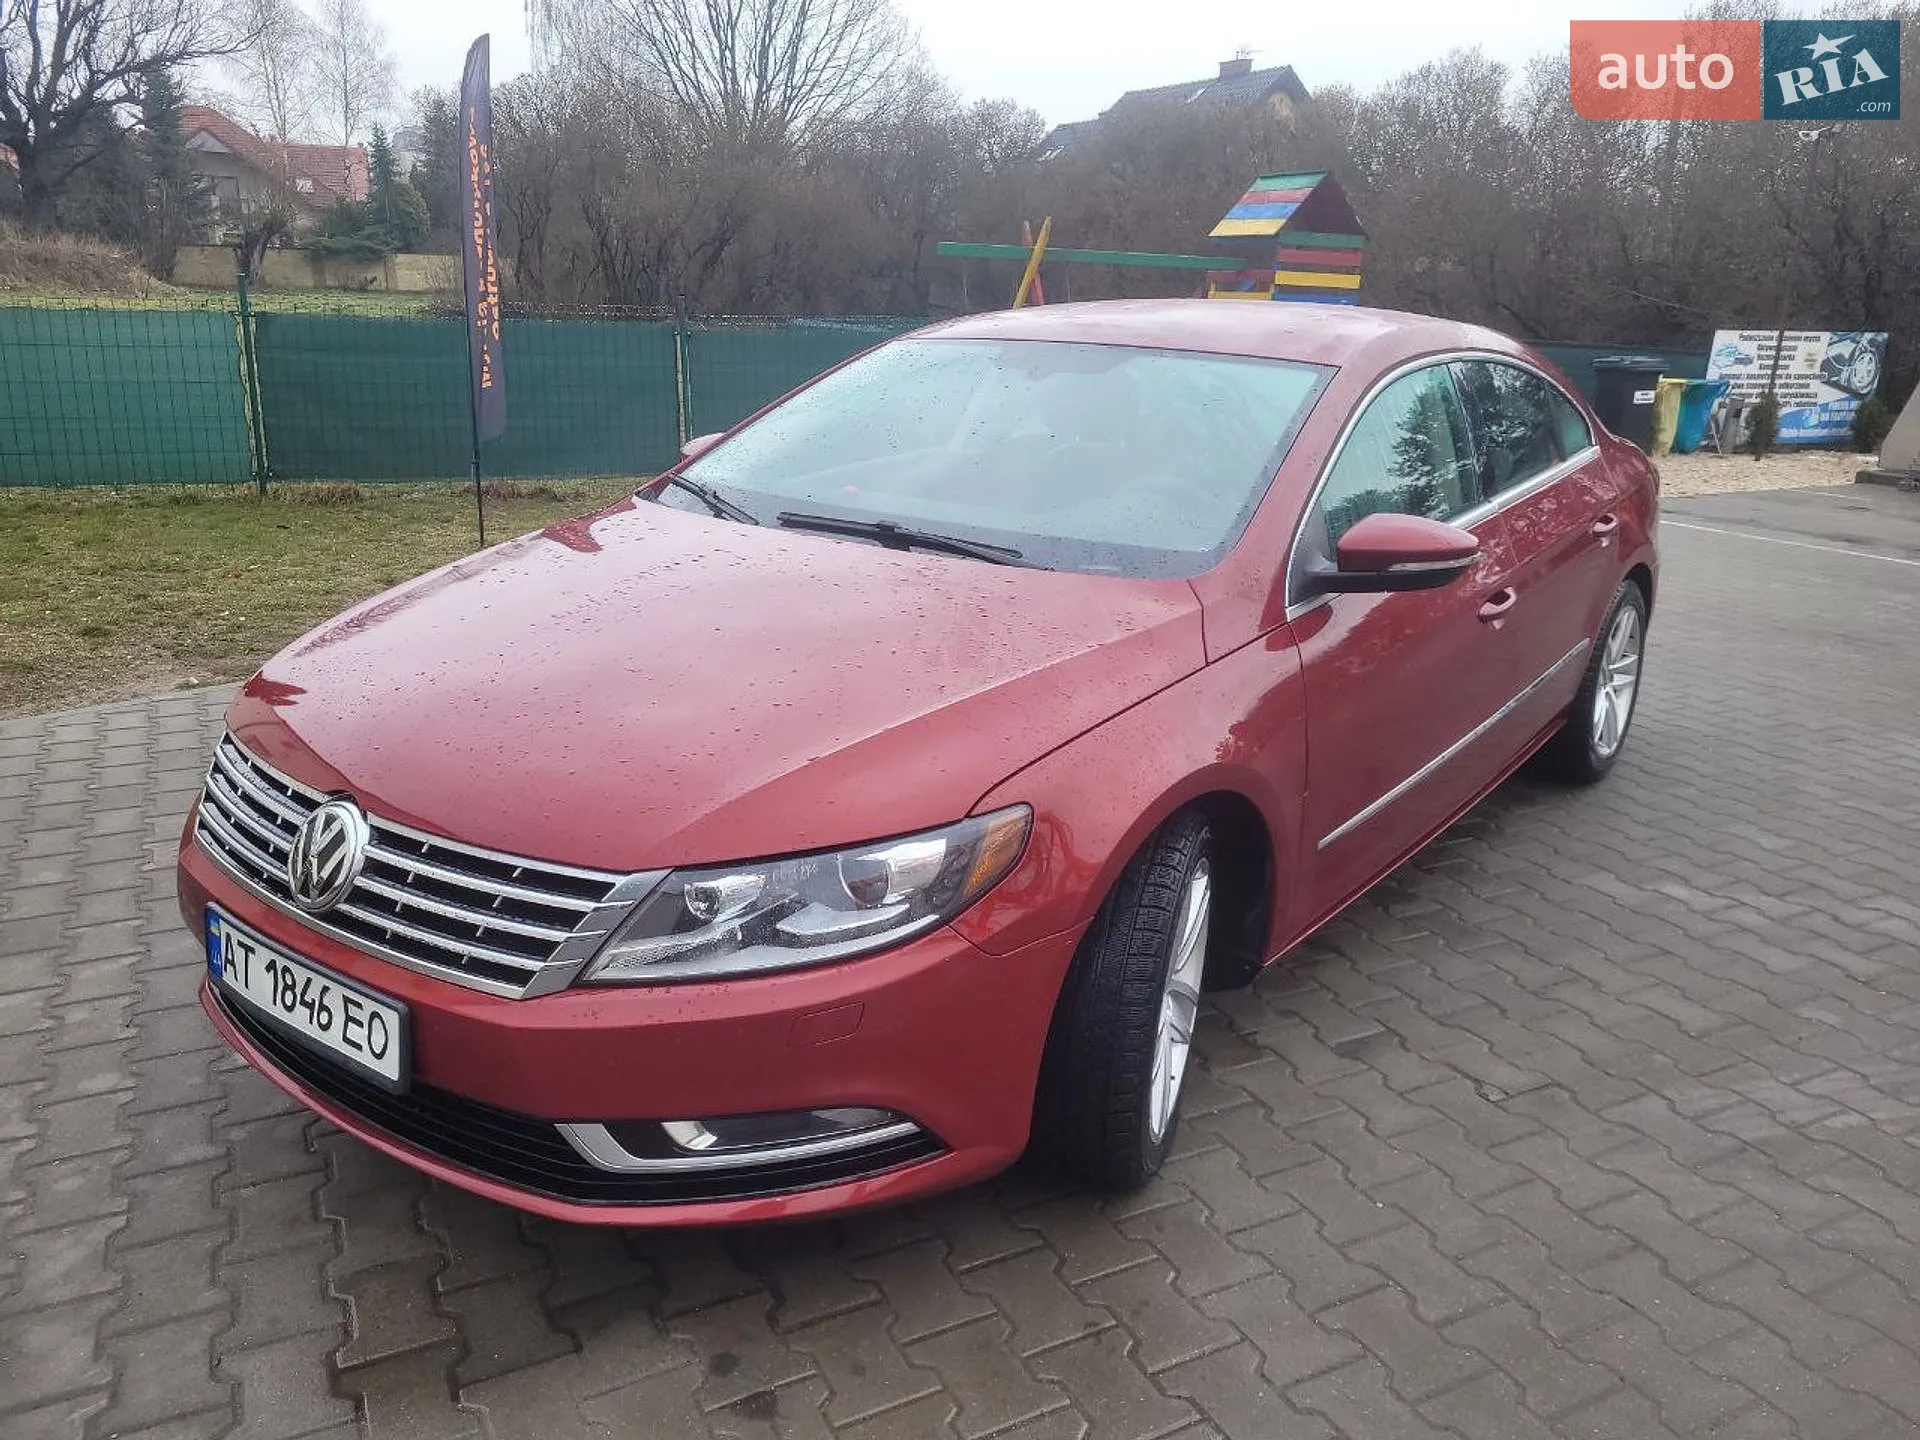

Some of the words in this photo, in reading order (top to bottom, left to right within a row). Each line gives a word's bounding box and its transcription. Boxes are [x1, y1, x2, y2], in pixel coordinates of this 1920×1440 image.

[223, 931, 256, 990] AT
[265, 959, 333, 1032] 1846
[342, 994, 389, 1060] EO
